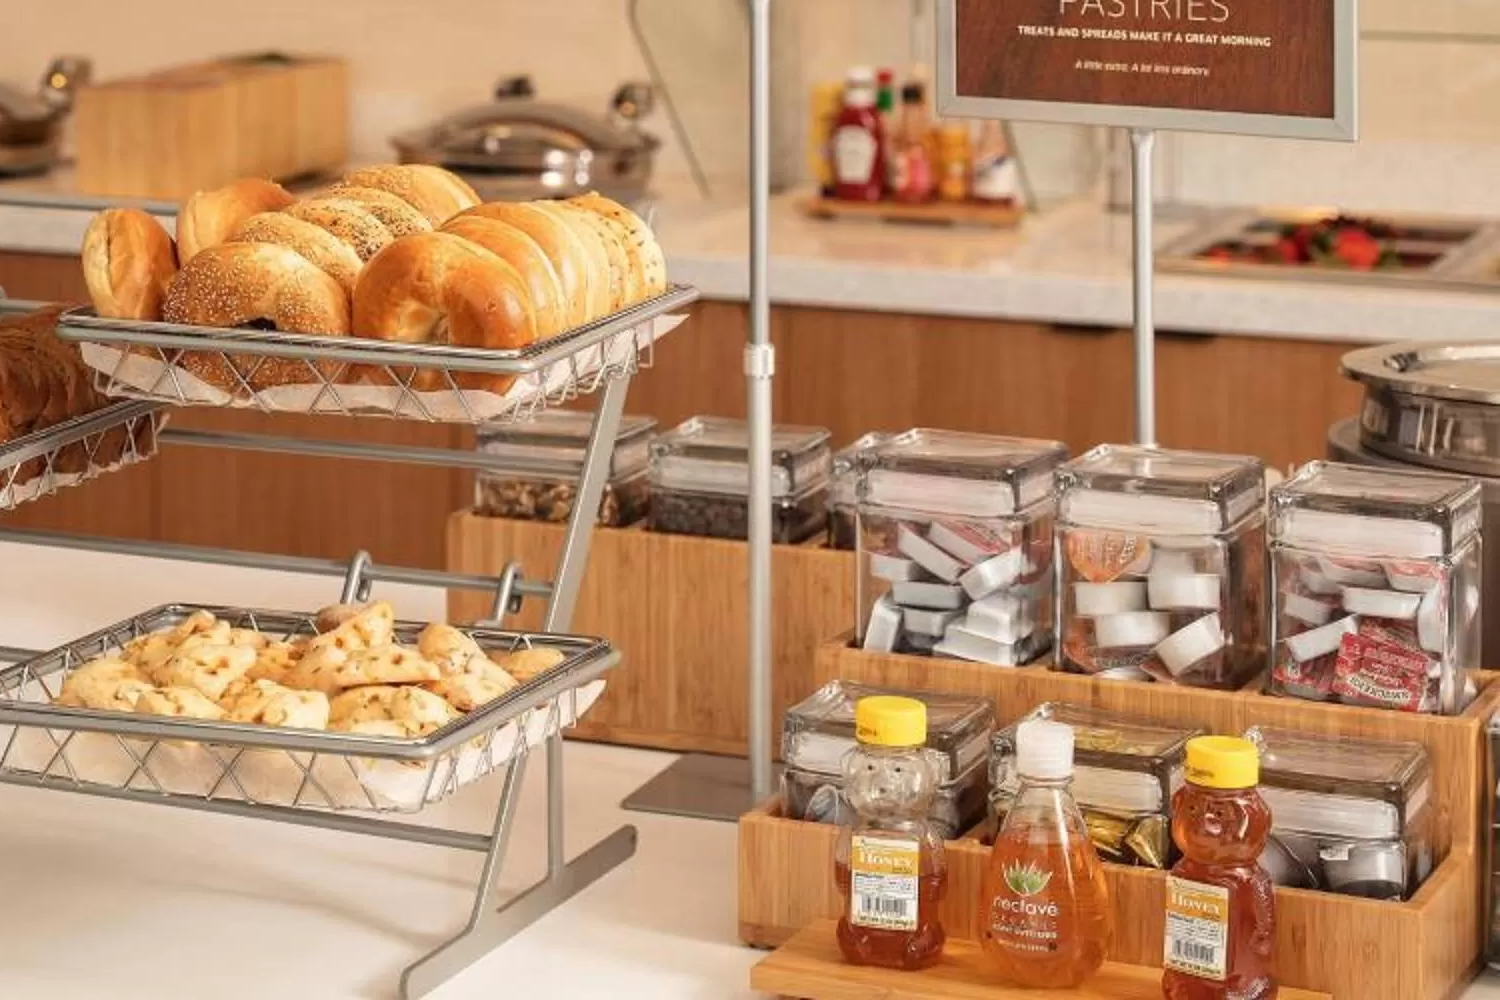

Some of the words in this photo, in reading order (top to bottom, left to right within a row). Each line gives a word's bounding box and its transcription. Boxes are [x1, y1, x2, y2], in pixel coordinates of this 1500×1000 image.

[1018, 25, 1055, 37] TREATS
[1057, 27, 1079, 38] AND
[1082, 28, 1127, 40] SPREADS
[1129, 30, 1160, 42] MAKE
[1162, 31, 1172, 42] IT
[1175, 32, 1183, 43] A
[1185, 33, 1218, 45] GREAT
[1220, 35, 1272, 48] MORNING
